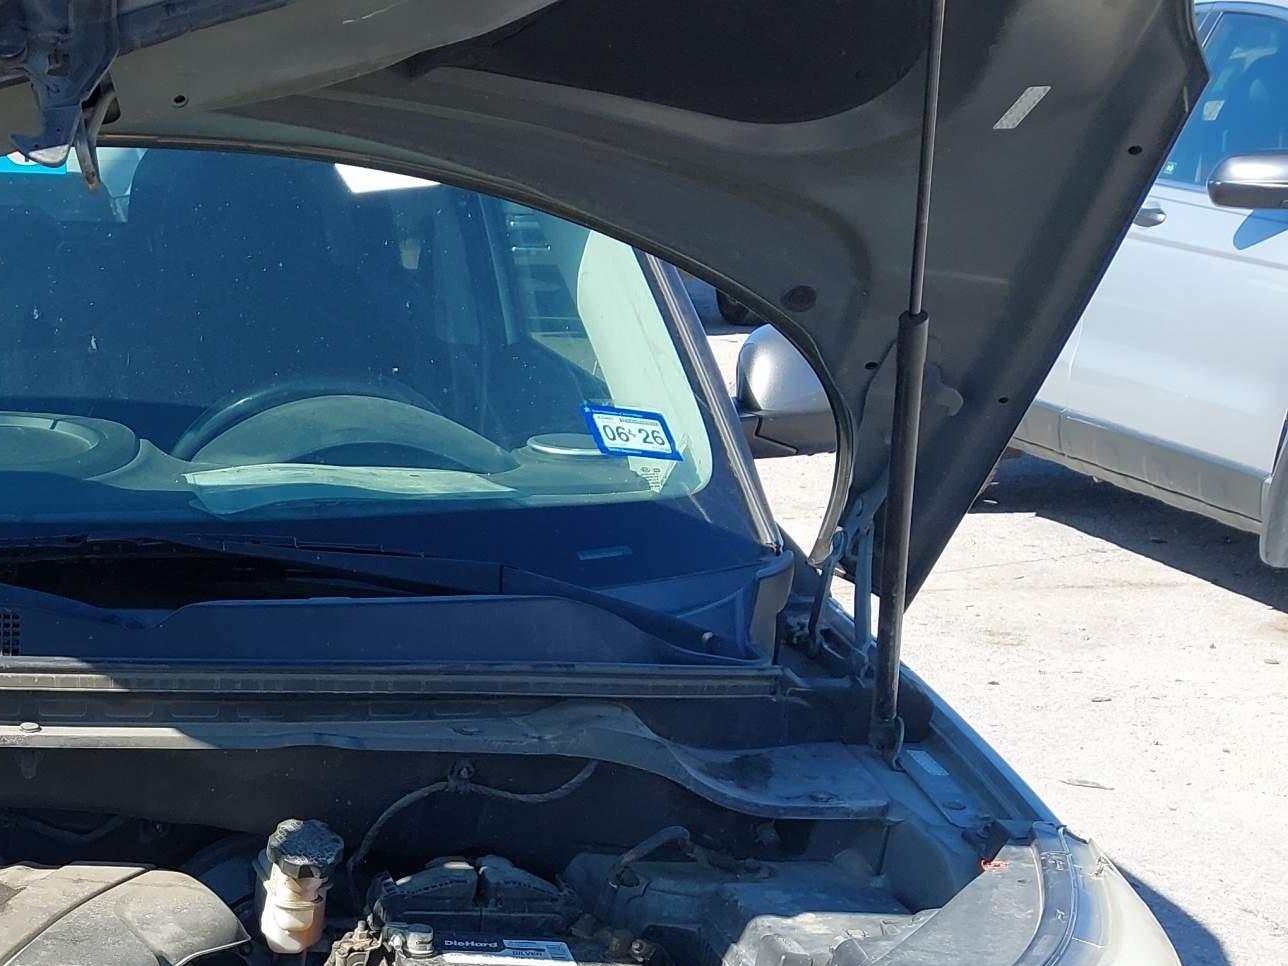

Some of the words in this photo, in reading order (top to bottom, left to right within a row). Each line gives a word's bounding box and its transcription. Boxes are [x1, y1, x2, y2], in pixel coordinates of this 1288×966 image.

[602, 424, 630, 443] 06
[637, 428, 666, 446] 26
[444, 939, 498, 949] DieHard
